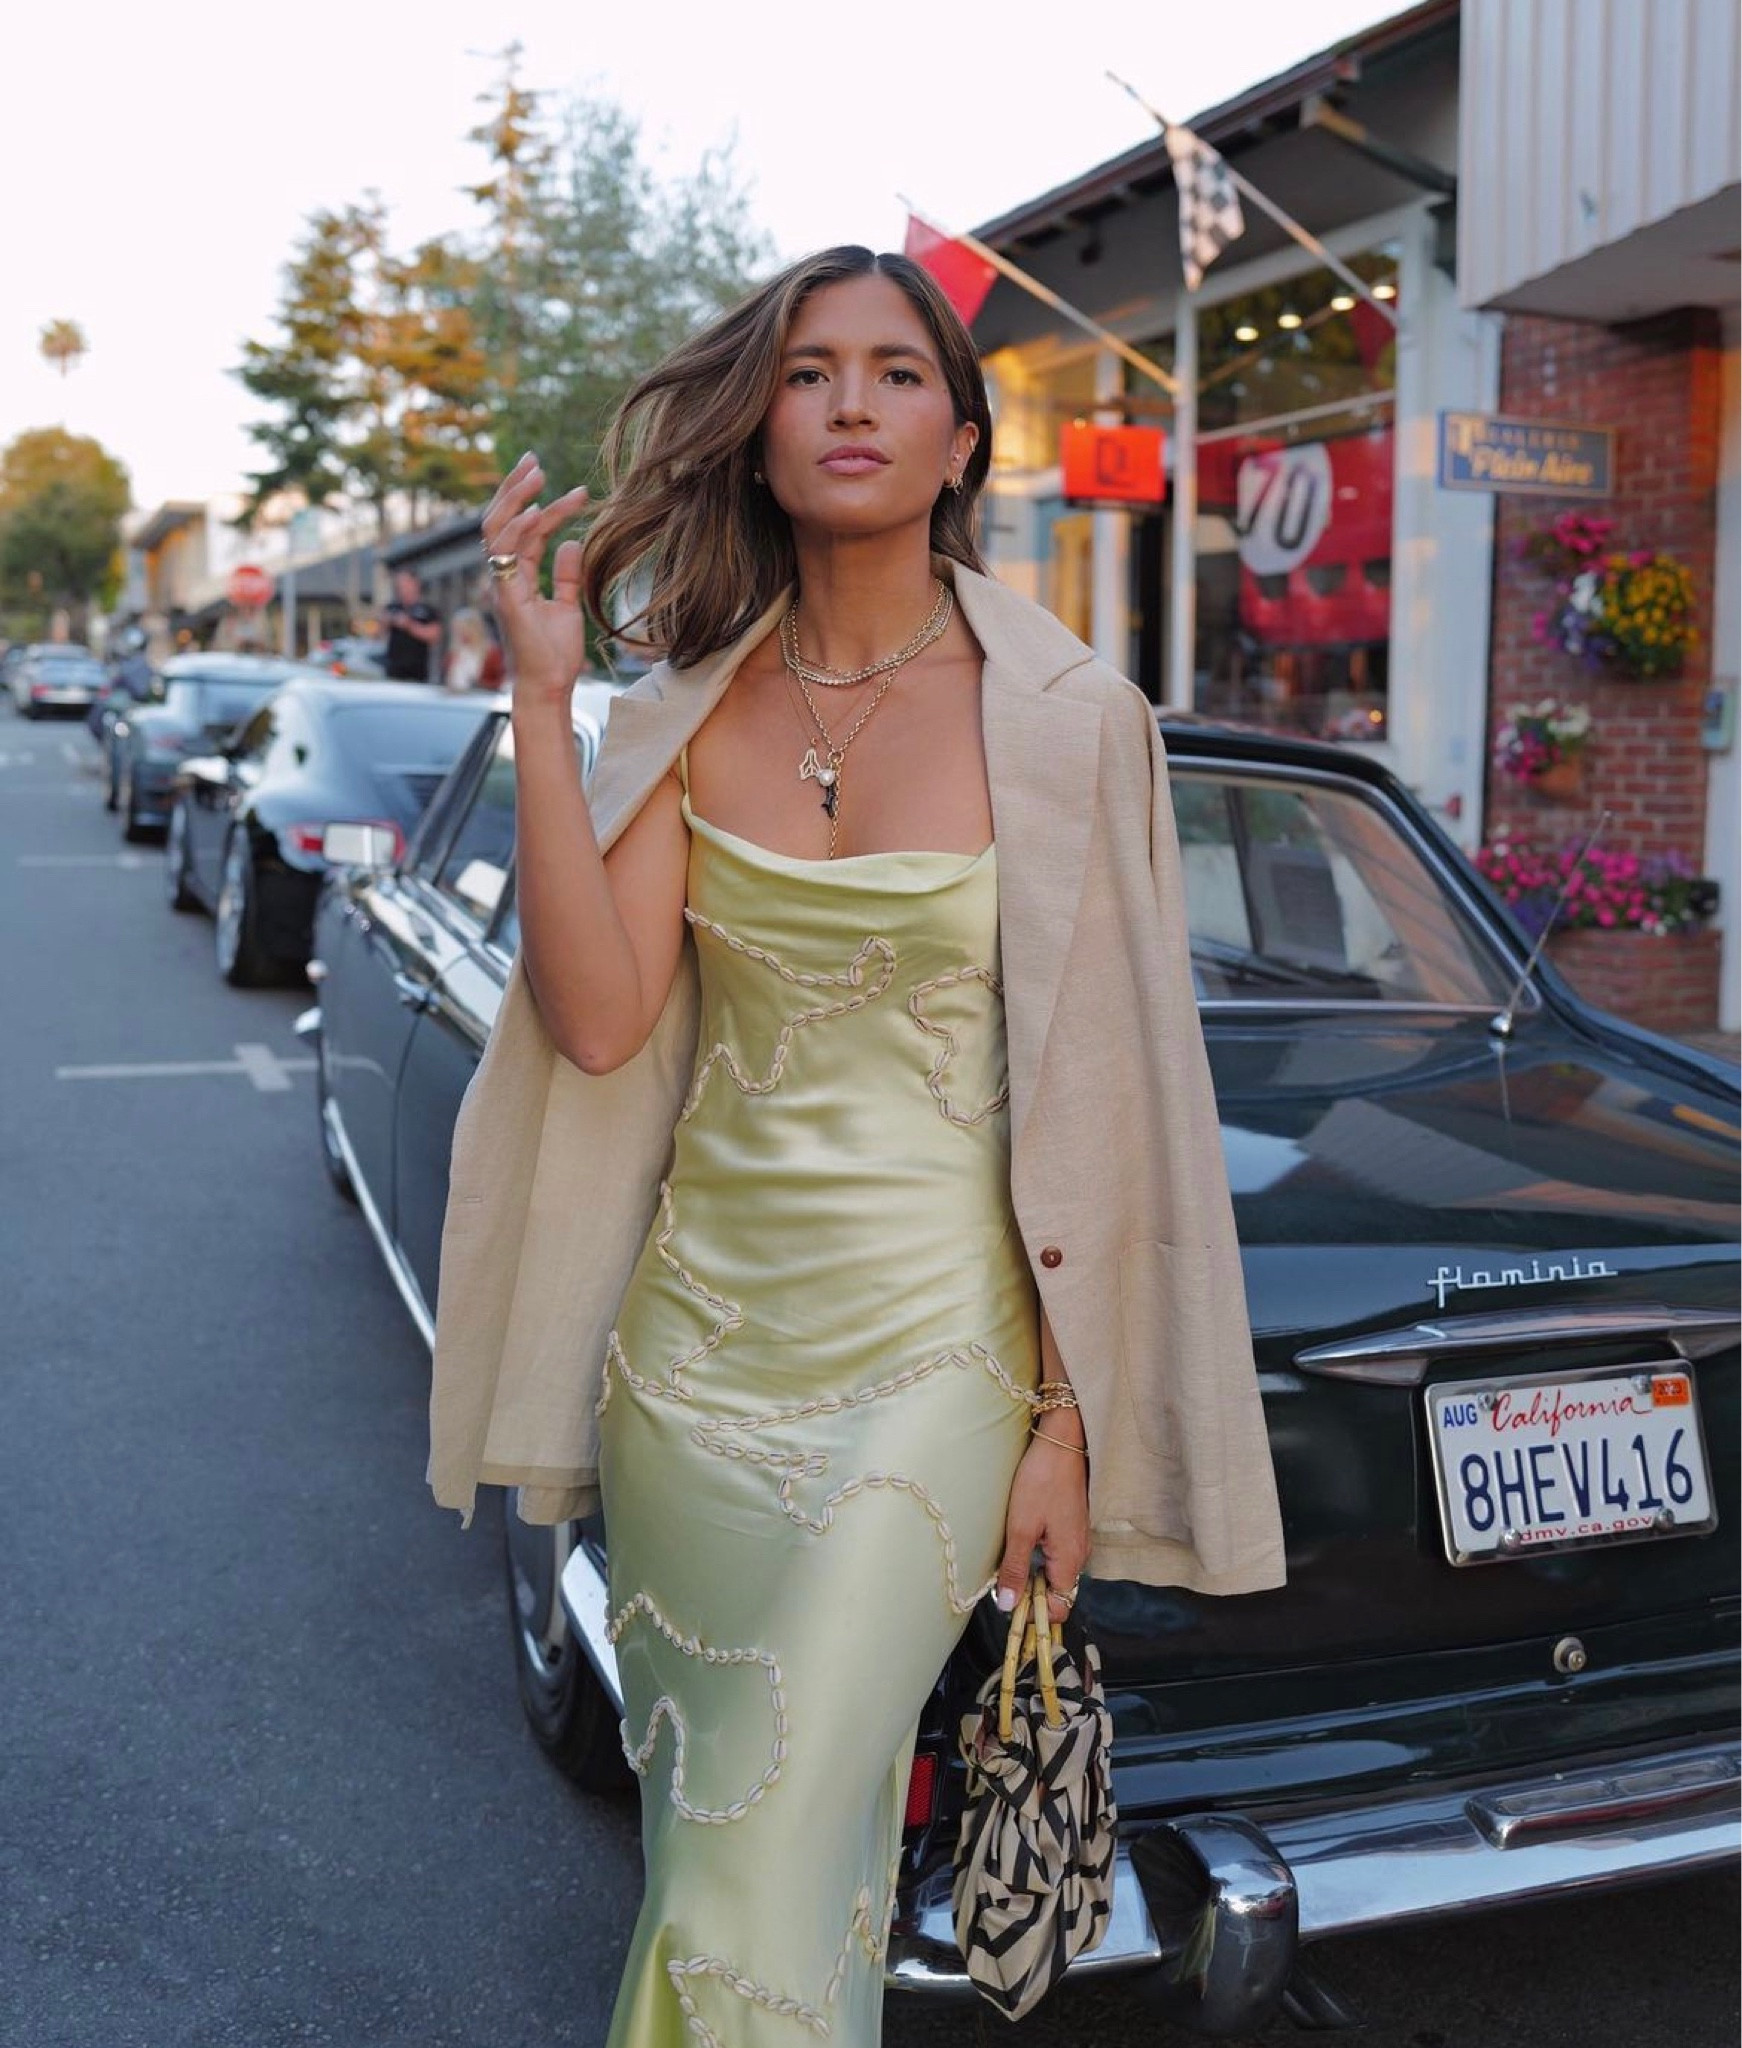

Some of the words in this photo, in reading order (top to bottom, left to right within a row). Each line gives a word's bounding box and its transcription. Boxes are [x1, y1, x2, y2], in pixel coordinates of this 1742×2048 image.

[1234, 449, 1318, 550] 70
[1427, 1256, 1618, 1308] flaminia
[1443, 1403, 1478, 1428] AUG
[1492, 1388, 1653, 1437] California
[1460, 1428, 1693, 1532] 8HEV416
[1520, 1516, 1652, 1542] dmv.ca.gov
